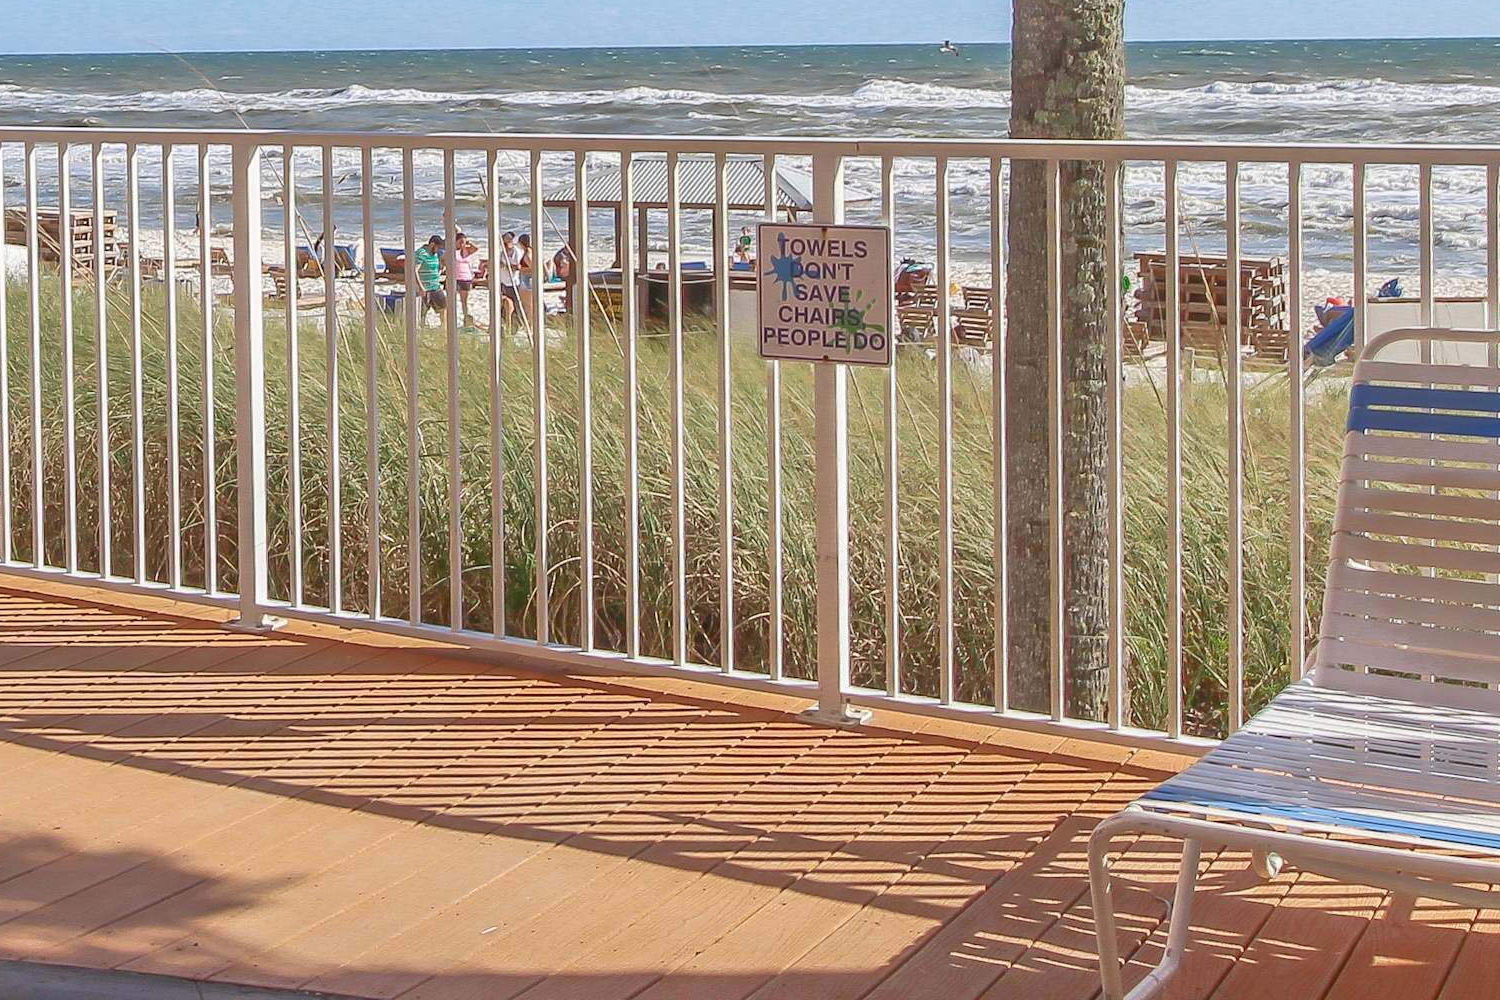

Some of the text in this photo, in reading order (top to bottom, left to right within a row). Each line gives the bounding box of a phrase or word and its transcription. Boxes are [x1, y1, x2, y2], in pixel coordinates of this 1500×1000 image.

[778, 238, 868, 259] TOWELS
[790, 261, 854, 281] DON'T
[795, 284, 851, 303] SAVE
[778, 305, 861, 326] CHAIRS
[763, 327, 885, 351] PEOPLE DO
